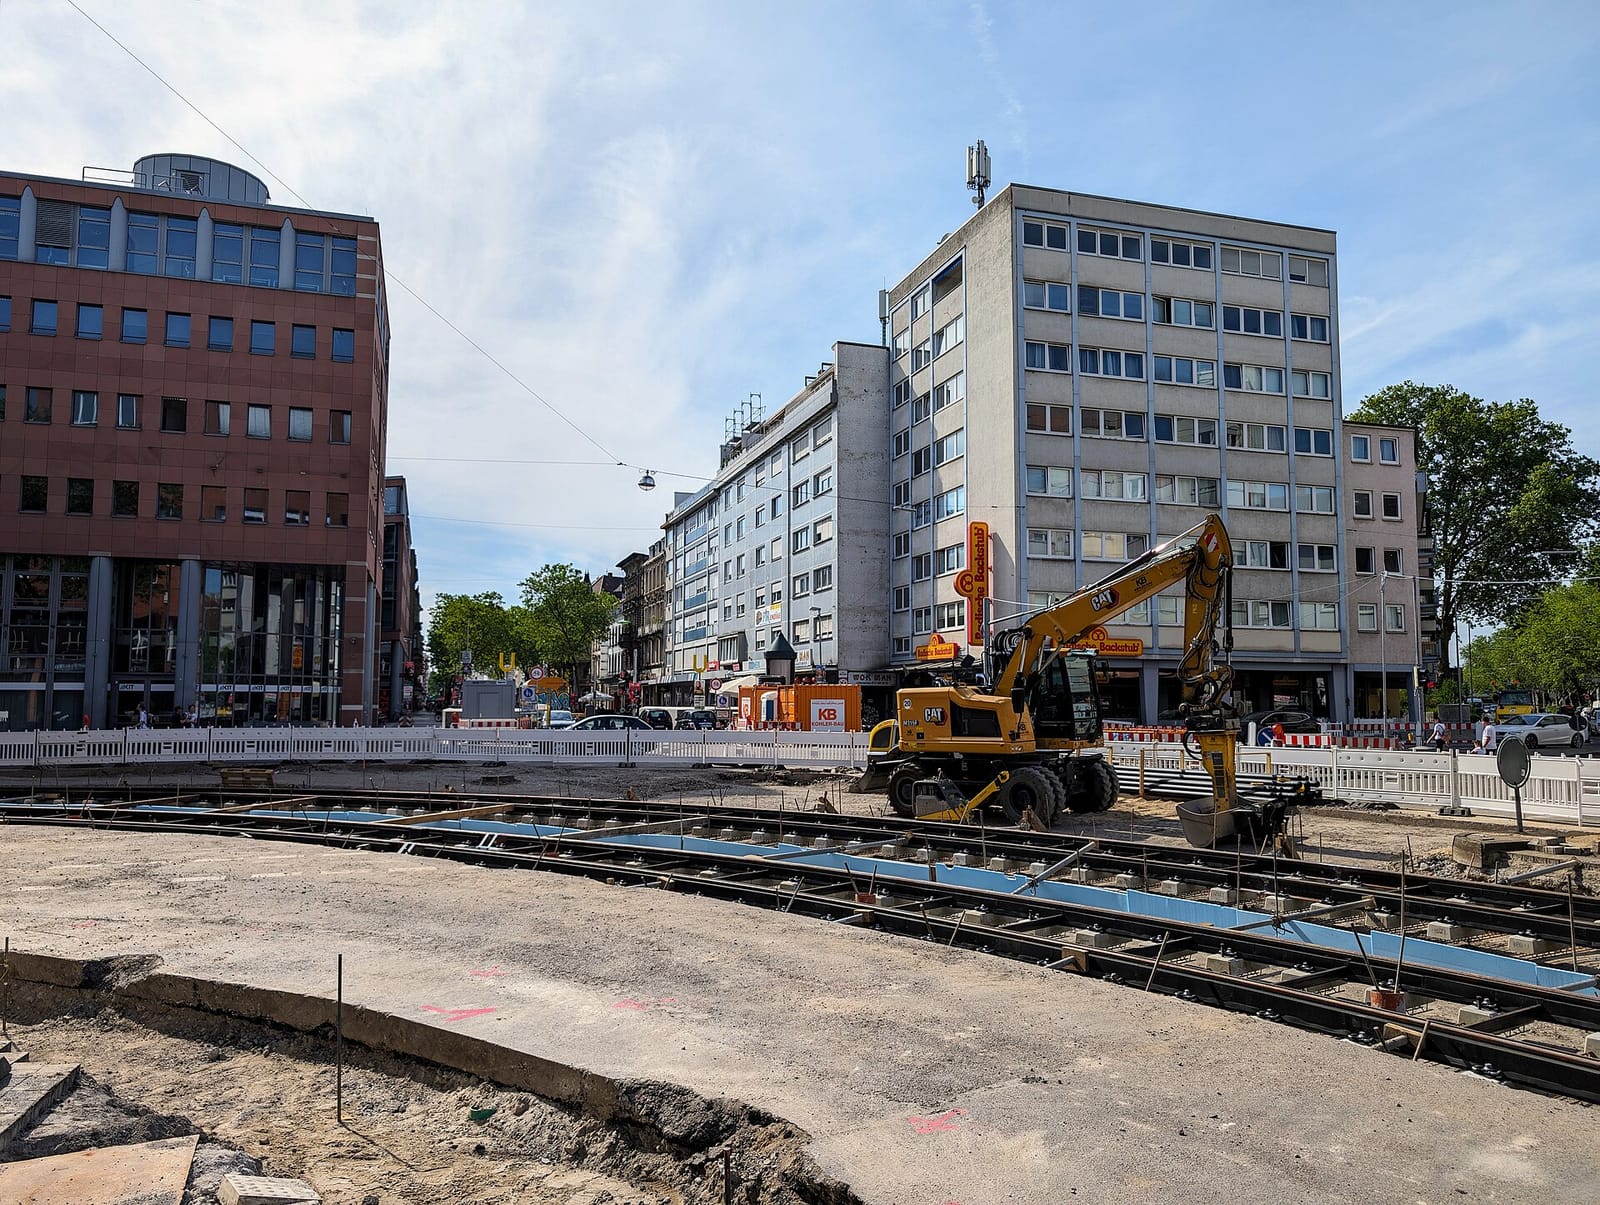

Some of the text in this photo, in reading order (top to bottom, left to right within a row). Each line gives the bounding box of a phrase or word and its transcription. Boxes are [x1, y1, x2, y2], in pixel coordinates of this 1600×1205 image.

[1135, 576, 1147, 587] KB
[1091, 589, 1113, 611] CAT
[818, 708, 837, 721] KB
[924, 708, 942, 722] CAT
